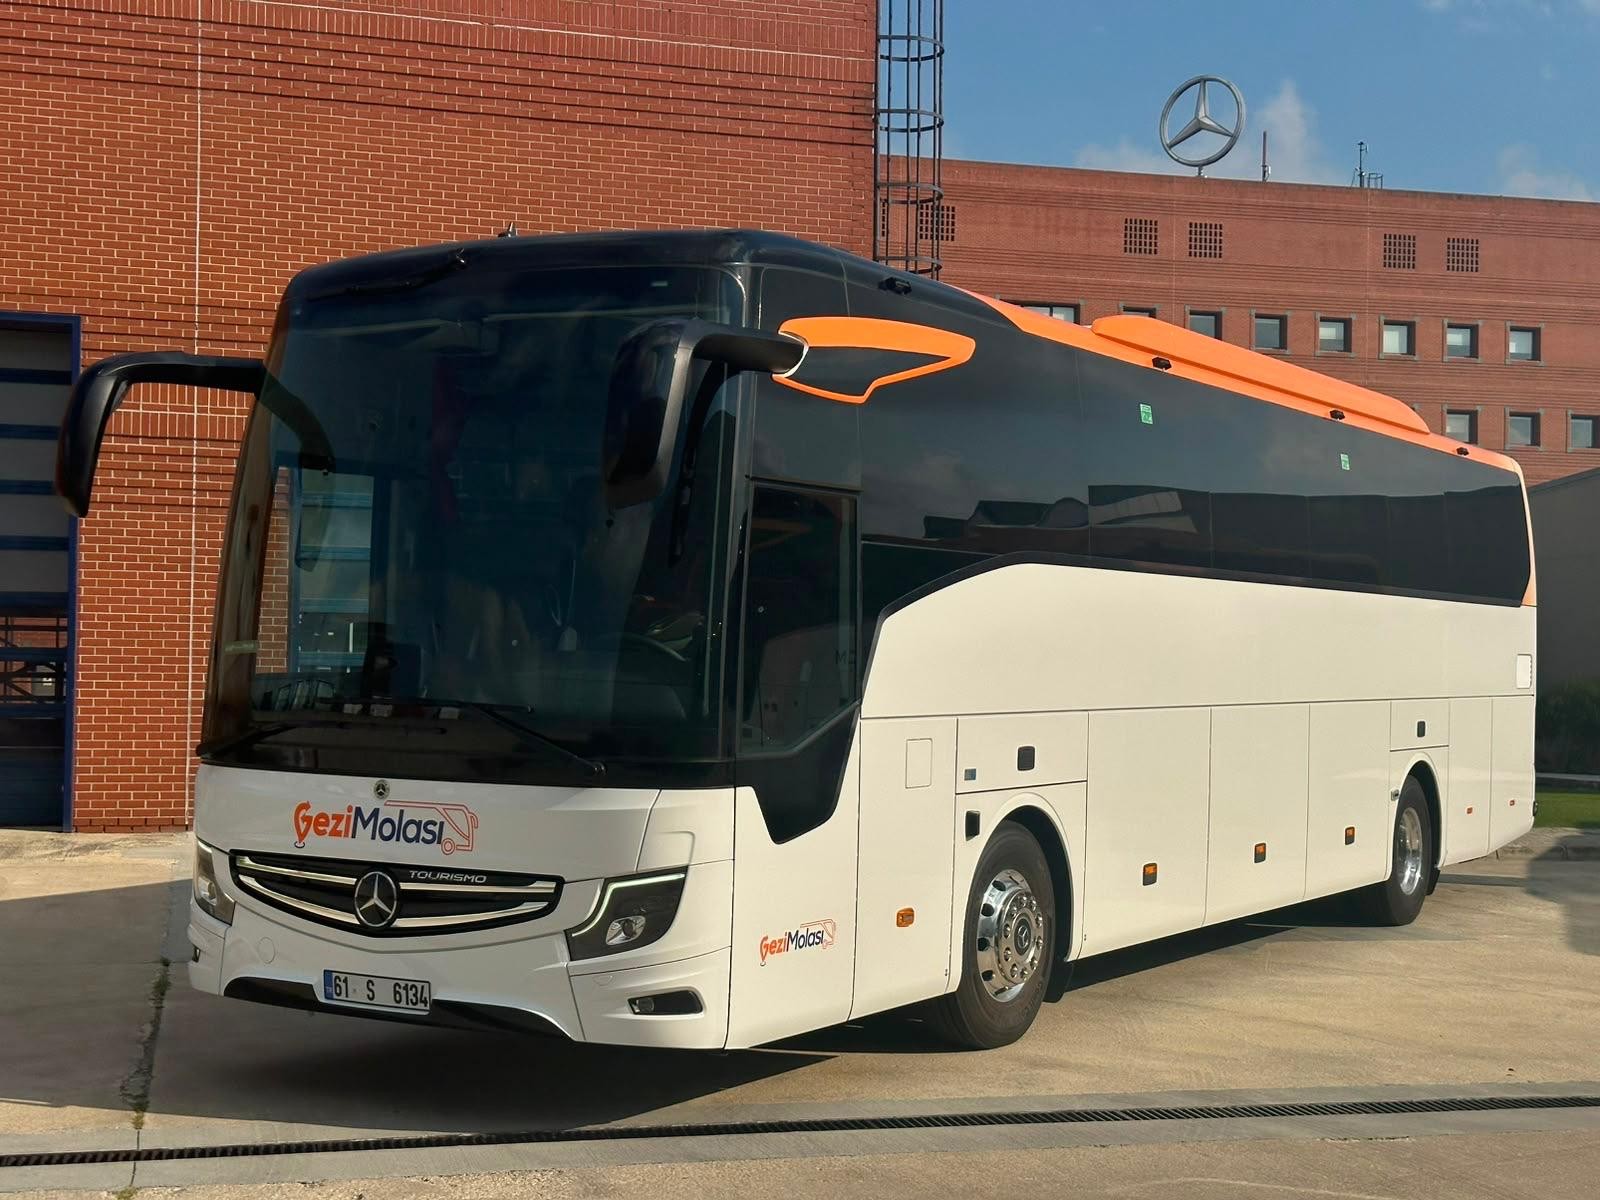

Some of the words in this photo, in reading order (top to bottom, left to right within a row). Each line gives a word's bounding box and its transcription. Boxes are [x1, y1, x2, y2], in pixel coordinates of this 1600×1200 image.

[409, 870, 487, 883] TOURISMO
[334, 975, 349, 998] 61
[366, 979, 375, 1001] S
[393, 982, 429, 1007] 6134
